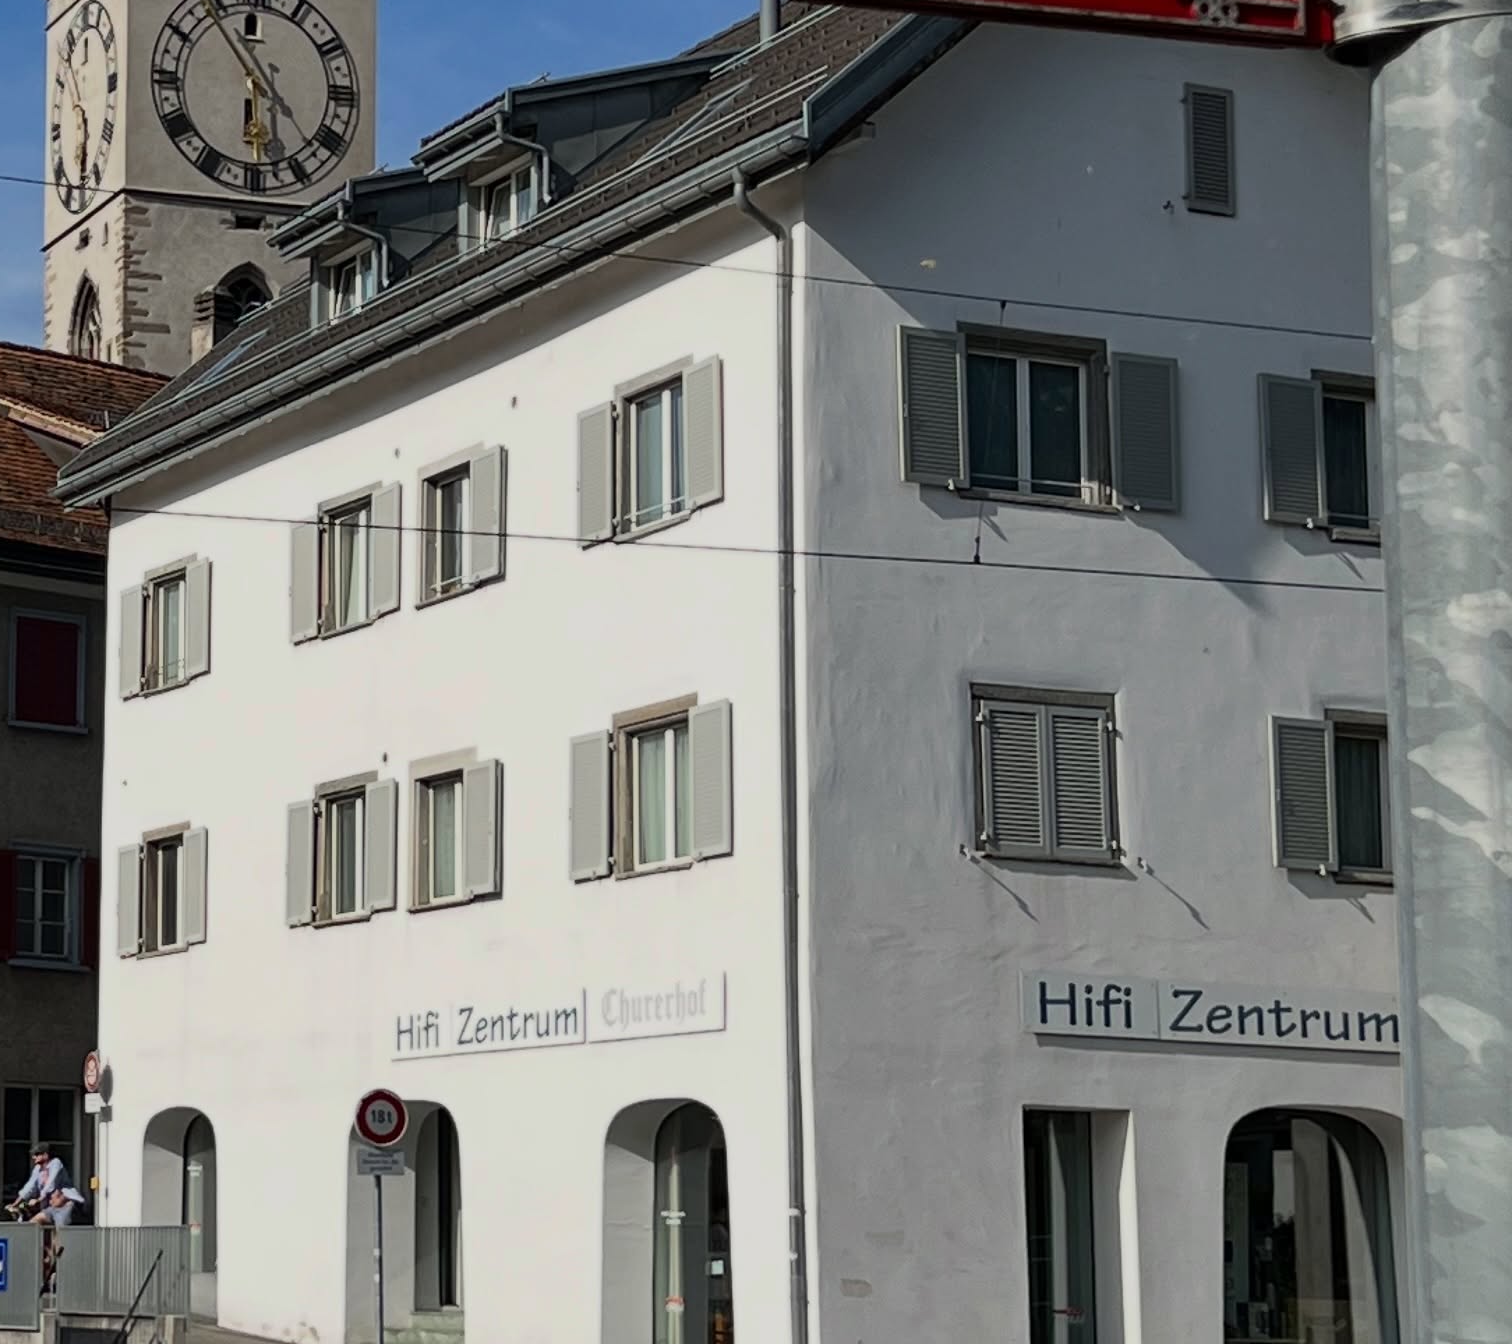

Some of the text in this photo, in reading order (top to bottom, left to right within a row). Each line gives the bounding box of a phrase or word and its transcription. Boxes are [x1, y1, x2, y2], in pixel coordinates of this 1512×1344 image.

[396, 1005, 578, 1051] Hifi Zentrum
[601, 978, 707, 1030] Churerhof
[1039, 981, 1400, 1044] Hifi Zentrum
